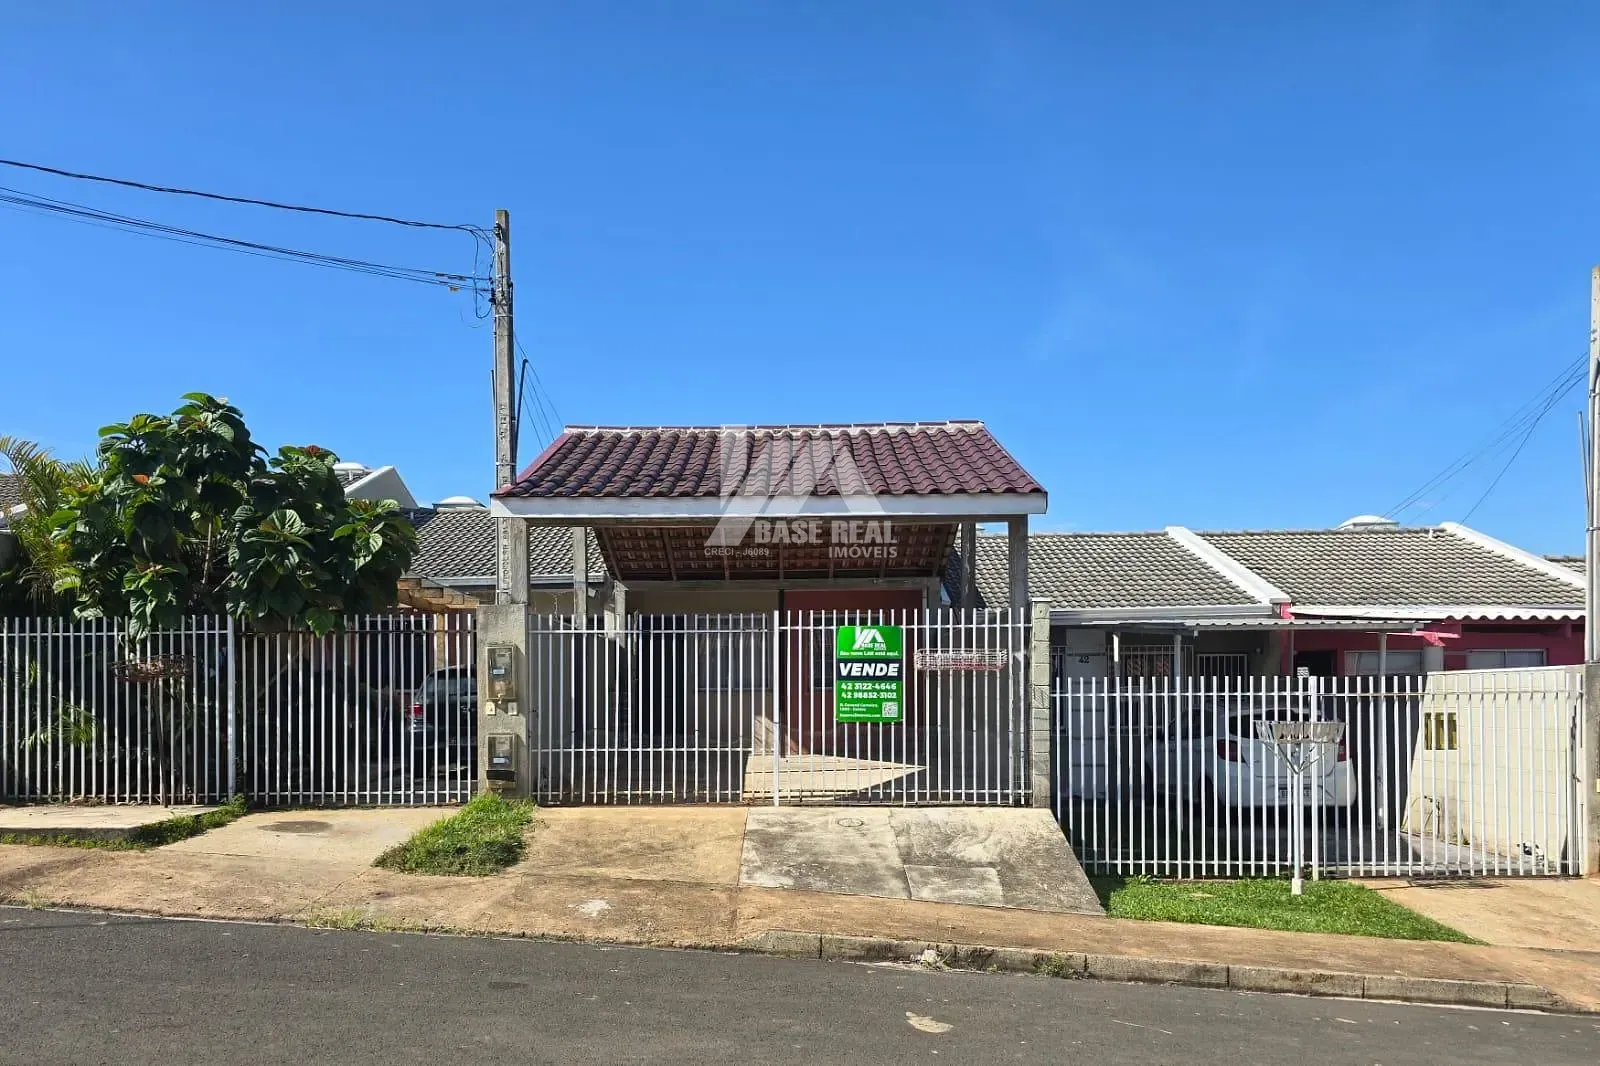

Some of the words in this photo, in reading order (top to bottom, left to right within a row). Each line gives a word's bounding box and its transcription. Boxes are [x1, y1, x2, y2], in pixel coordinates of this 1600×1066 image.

[1078, 655, 1090, 664] 42
[839, 662, 899, 677] VENDE
[841, 682, 853, 690] 42
[854, 682, 897, 690] 3122-4646
[841, 691, 853, 699] 42
